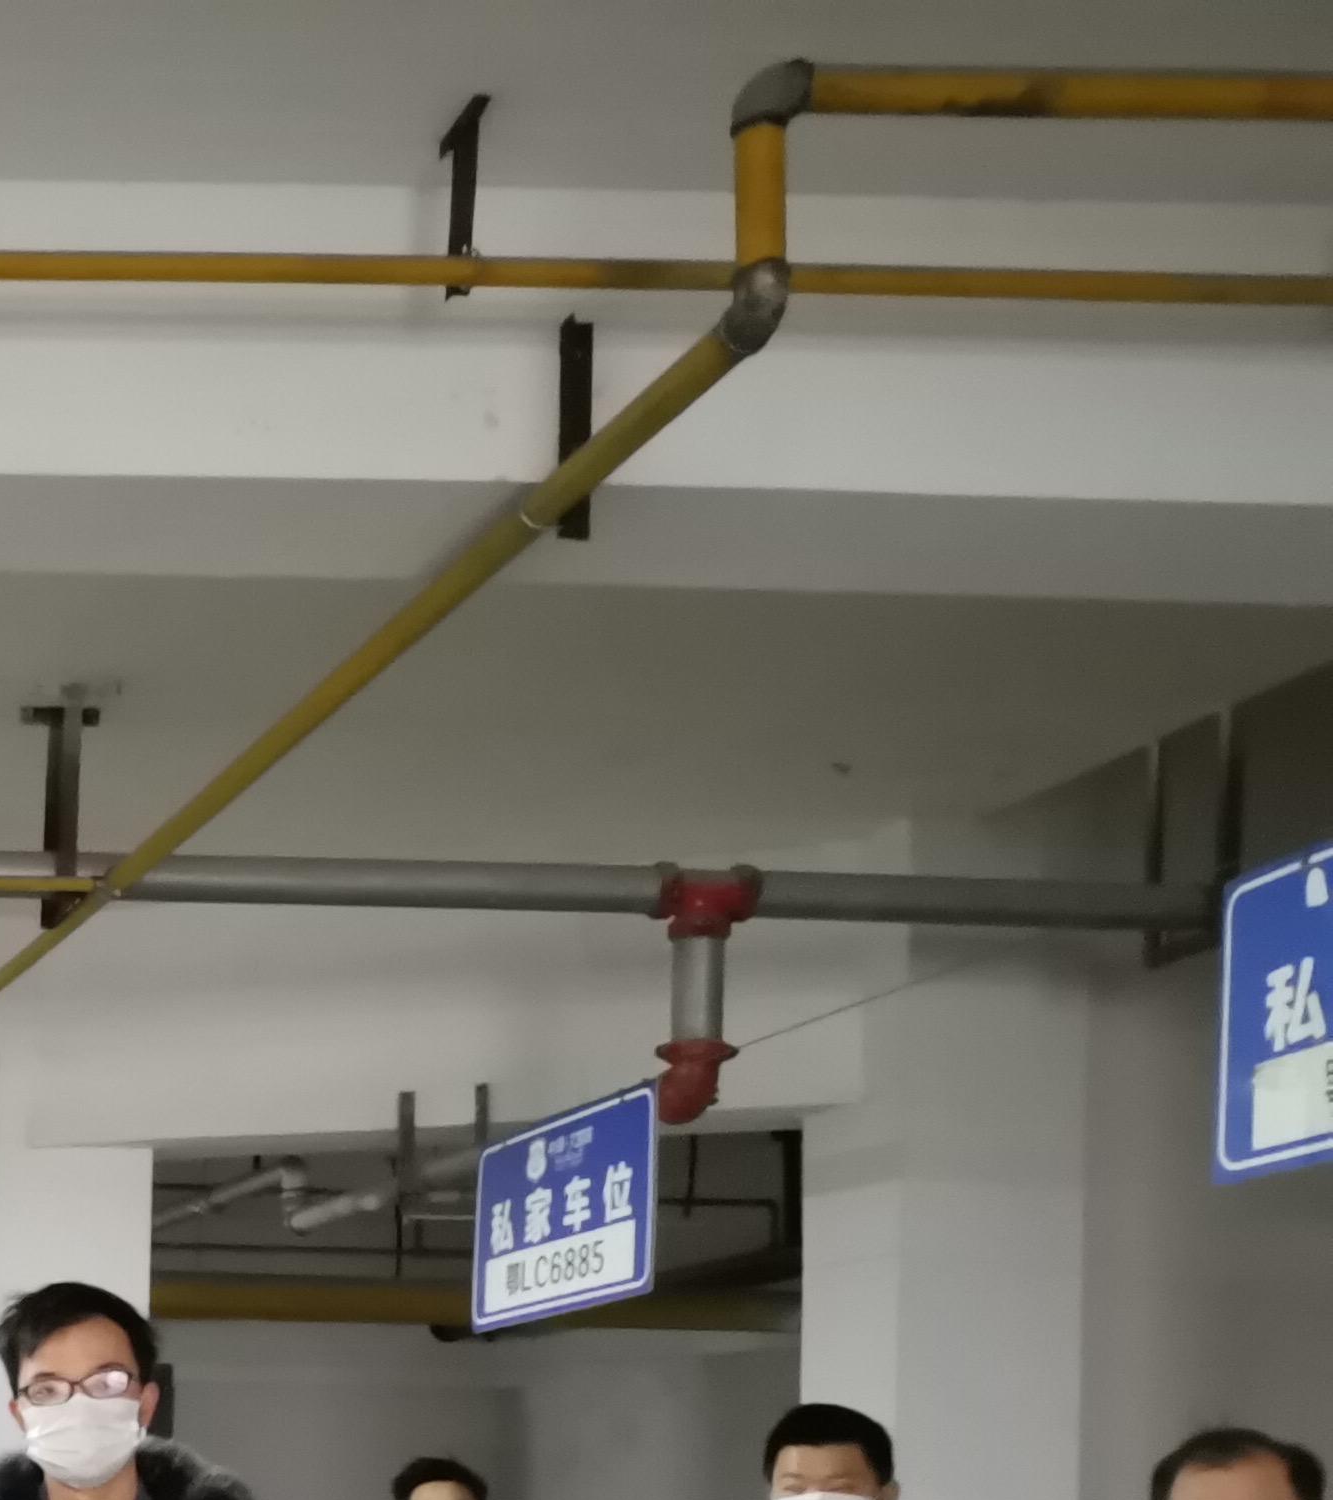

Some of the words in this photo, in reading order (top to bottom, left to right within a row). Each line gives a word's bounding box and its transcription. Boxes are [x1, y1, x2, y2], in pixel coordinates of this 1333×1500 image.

[1264, 956, 1327, 1053] 私
[490, 1161, 633, 1255] 私家车位
